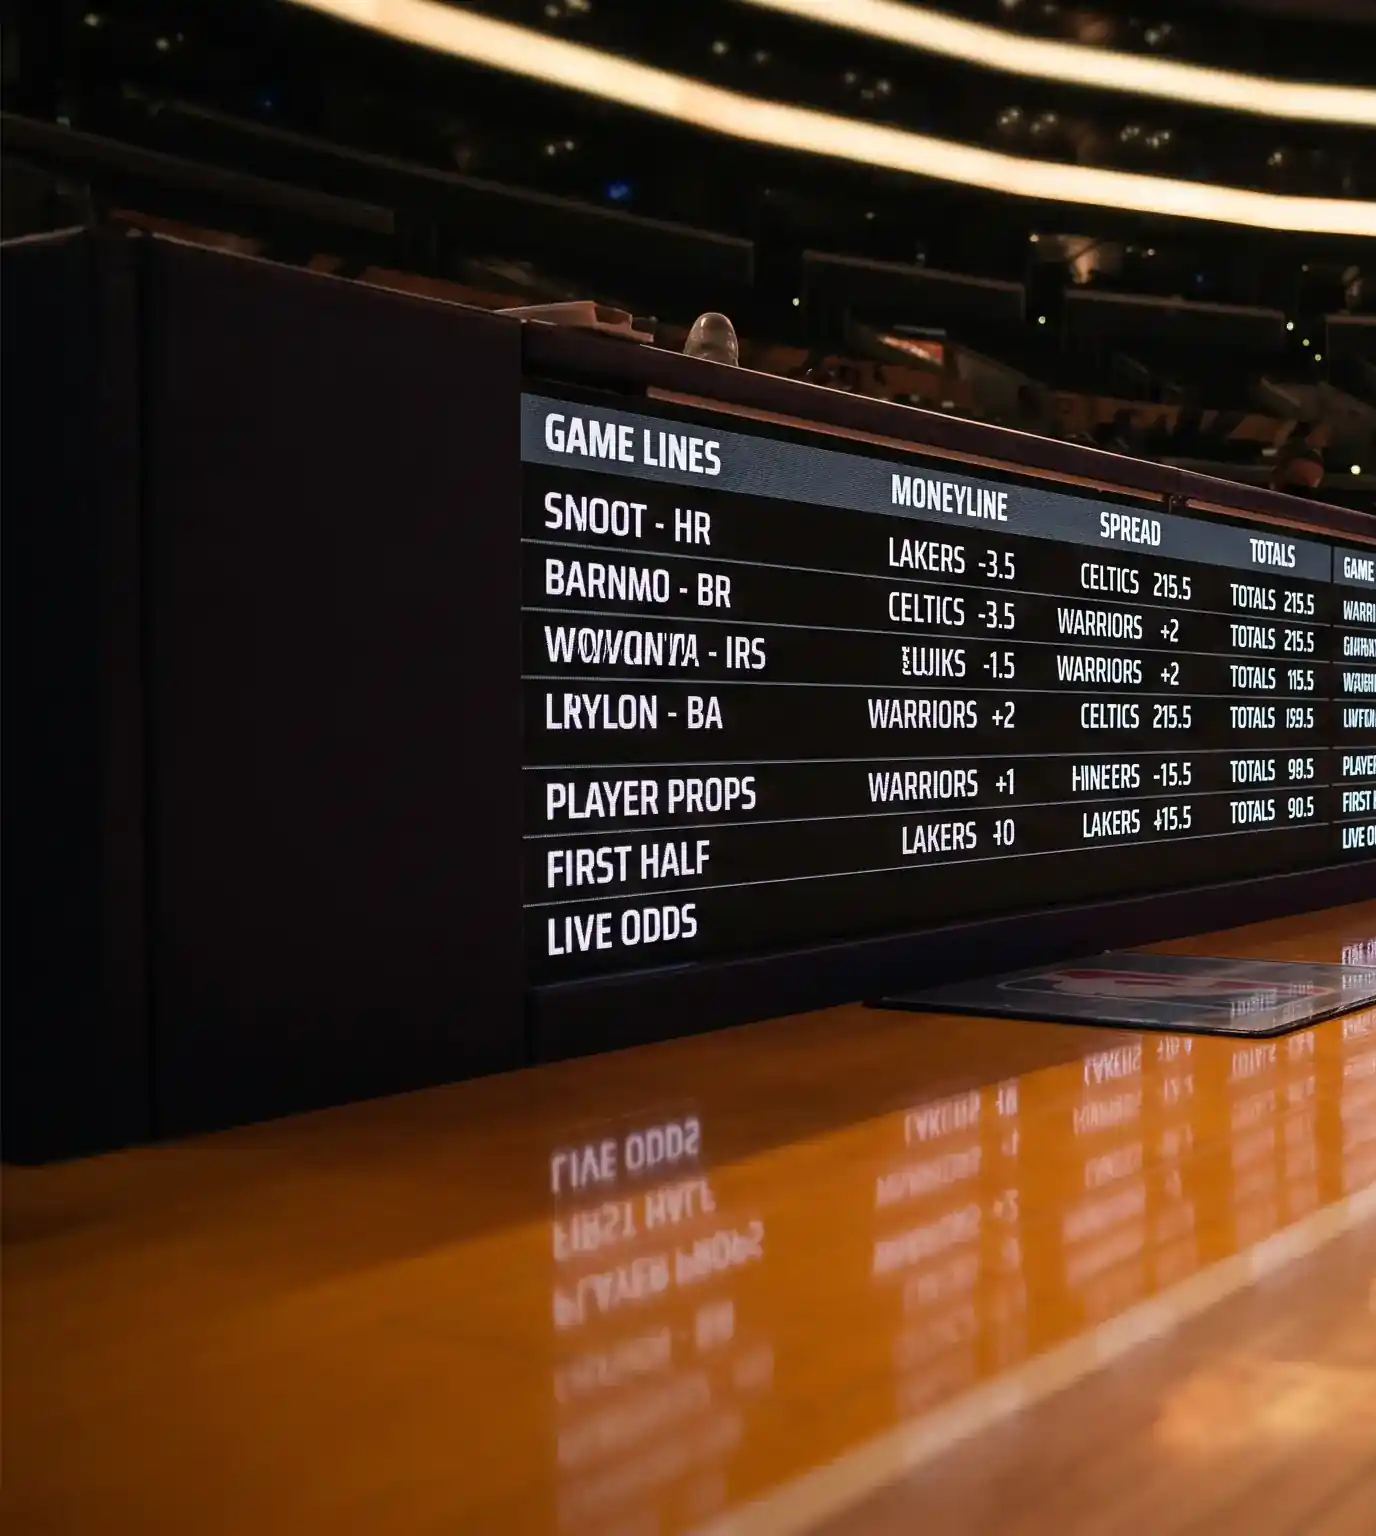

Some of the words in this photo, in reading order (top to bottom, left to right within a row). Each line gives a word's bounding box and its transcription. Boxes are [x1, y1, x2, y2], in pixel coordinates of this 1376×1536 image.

[545, 412, 635, 463] GAME
[643, 428, 722, 476] LINES
[891, 473, 1009, 522] MONEYLINE
[544, 491, 648, 538] SNOOT
[674, 507, 711, 546] HR
[1099, 511, 1161, 547] SPREAD
[889, 536, 966, 574] LAKERS
[978, 549, 1015, 580] -3.5
[1249, 538, 1296, 568] TOTALS
[1343, 556, 1375, 582] GAME
[545, 558, 670, 603] BARNMO
[697, 572, 731, 608] BR
[1080, 562, 1140, 595] CELTICS
[1153, 572, 1192, 601] 215.5
[888, 591, 965, 626] CELTICS
[978, 600, 1015, 630] -3.5
[1230, 583, 1277, 611] TOTALS
[1283, 590, 1315, 615] 215.5
[1057, 607, 1143, 640] WARRIORS
[1160, 618, 1179, 643] +2
[1229, 624, 1276, 650] TOTALS
[1283, 629, 1314, 653] 215.5
[726, 635, 766, 670] IRS
[983, 651, 1015, 679] -1.5
[1056, 654, 1143, 684] WARRIORS
[1160, 661, 1180, 686] +2
[1229, 664, 1276, 690] TOTALS
[1287, 669, 1314, 691] 115.5
[687, 695, 723, 729] BA
[867, 698, 978, 729] WARRIORS
[991, 701, 1015, 729] +2
[1080, 702, 1140, 729] CELTICS
[1152, 703, 1192, 729] 215.5
[1229, 706, 1276, 729] TOTALS
[868, 769, 979, 803] WARRIORS
[995, 768, 1014, 795] +1
[1153, 762, 1192, 787] -15.5
[1229, 759, 1276, 783] TOTALS
[546, 779, 659, 821] PLAYER
[668, 776, 756, 814] PROPS
[1229, 798, 1276, 824] TOTALS
[1287, 795, 1314, 819] 90.5
[1342, 790, 1372, 813] FIRST
[902, 821, 977, 855] LAKERS
[1083, 808, 1141, 838] LAKERS
[1342, 826, 1365, 849] LIVE
[547, 845, 633, 889] FIRST
[640, 839, 710, 880] HALF
[548, 912, 613, 956] LIVE
[621, 903, 698, 946] ODDS
